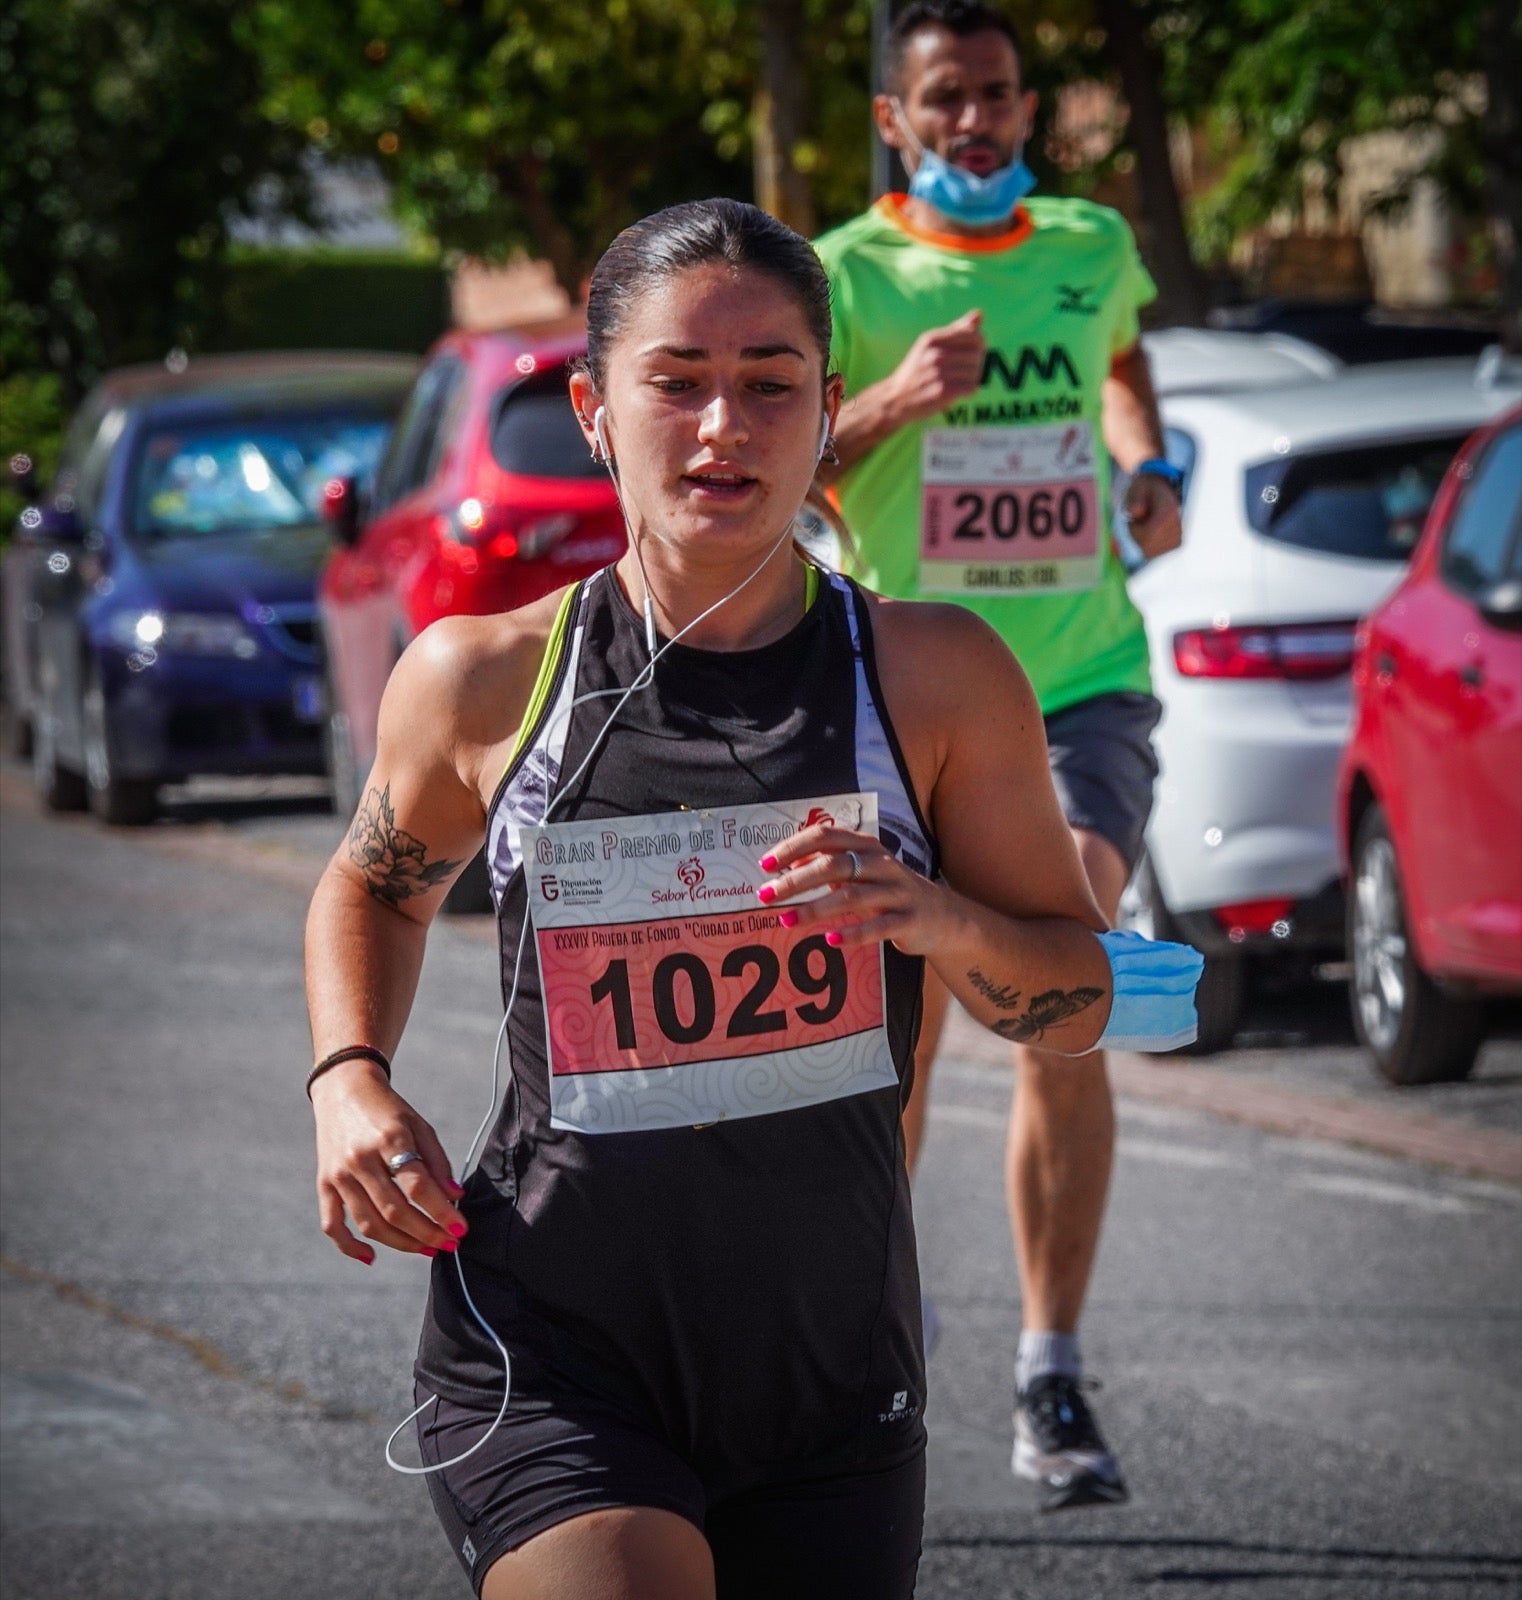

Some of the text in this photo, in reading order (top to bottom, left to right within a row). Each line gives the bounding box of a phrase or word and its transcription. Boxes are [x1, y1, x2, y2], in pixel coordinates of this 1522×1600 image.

[953, 487, 1085, 541] 2060
[536, 818, 795, 866] GRAN PREMIO DE FONDO
[561, 878, 602, 888] Diputación
[562, 887, 603, 897] de Granada
[652, 881, 754, 904] Sabor Granada
[553, 931, 589, 950] XXXVIX
[592, 931, 629, 947] PRUEBA
[631, 930, 644, 945] DE
[646, 926, 681, 943] FONDO
[733, 919, 745, 934] DE
[748, 914, 783, 932] DÚRCA
[591, 933, 848, 1050] 1029
